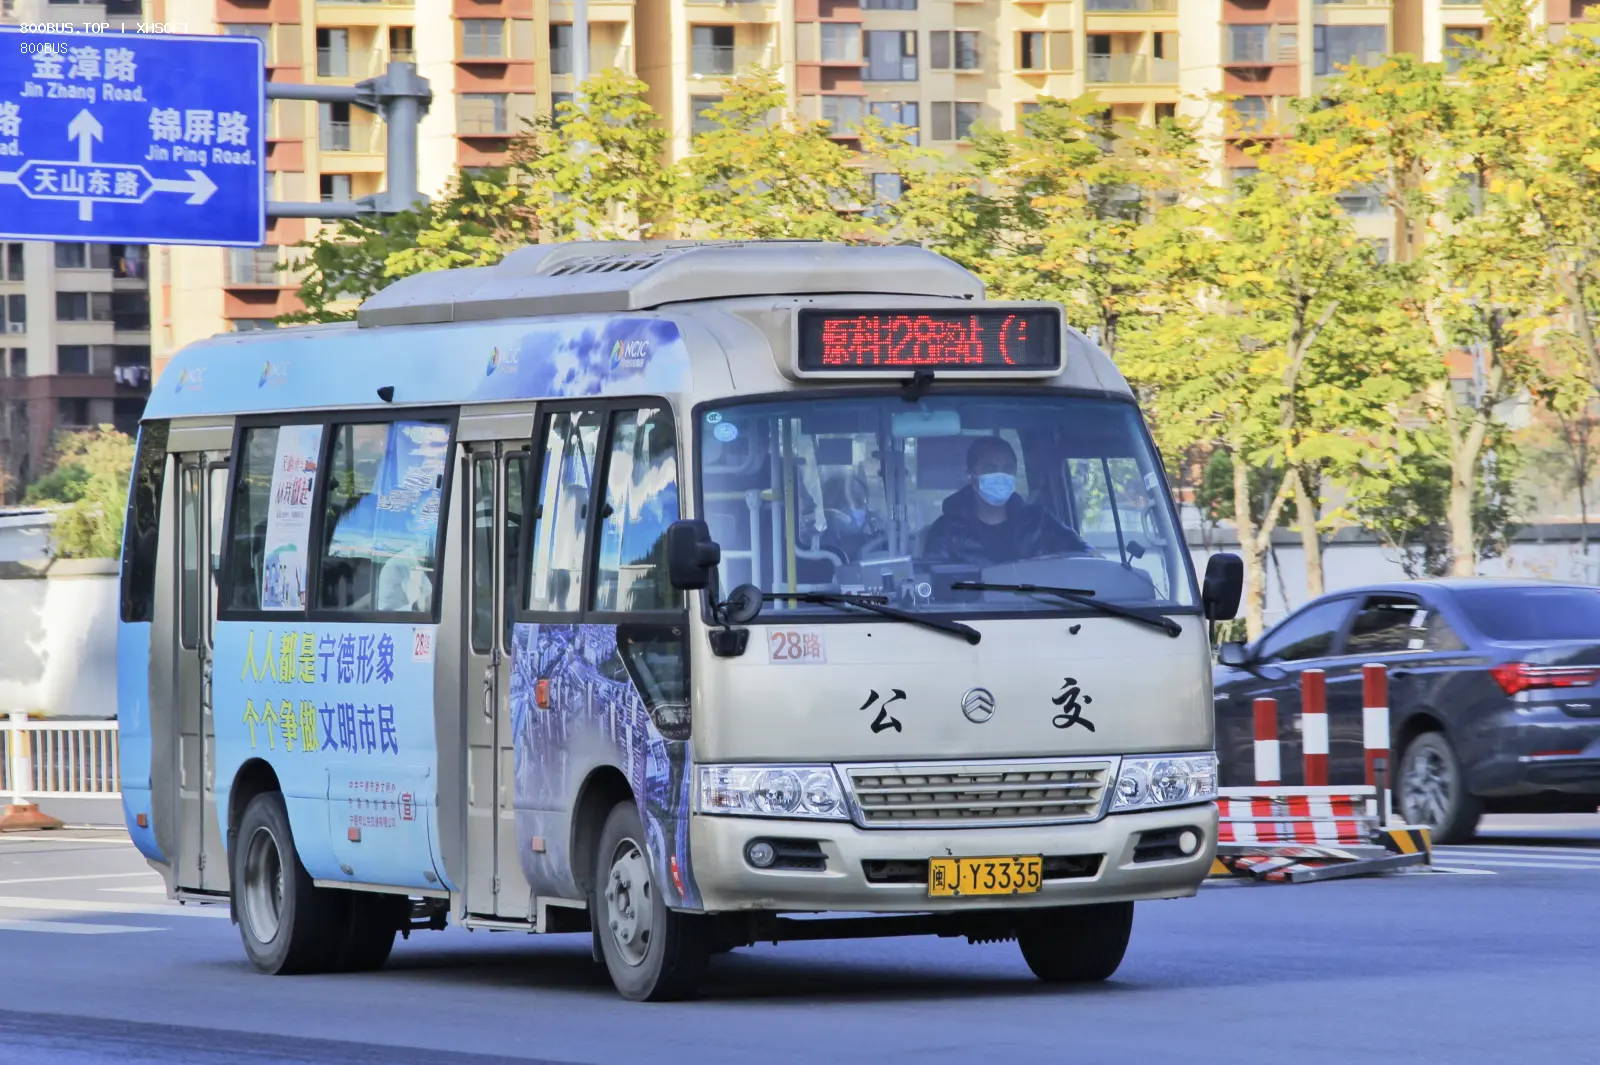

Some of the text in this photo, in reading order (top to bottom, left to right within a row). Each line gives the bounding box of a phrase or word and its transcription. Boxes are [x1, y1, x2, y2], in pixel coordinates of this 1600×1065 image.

[31, 46, 138, 82] 金漳路
[20, 81, 44, 97] Jin
[47, 82, 96, 104] Zhang
[148, 107, 250, 146] 锦屏路
[144, 144, 169, 161] Jin
[173, 146, 208, 166] Ping
[34, 168, 140, 197] 天山东路
[625, 340, 650, 357] NCIC
[240, 629, 395, 684] 人人都是宁德形象
[772, 631, 821, 660] 28路
[859, 677, 1096, 733] 公 交
[241, 698, 399, 755] 个个争做文明市民
[932, 861, 1040, 891] 闽J·Y3335
